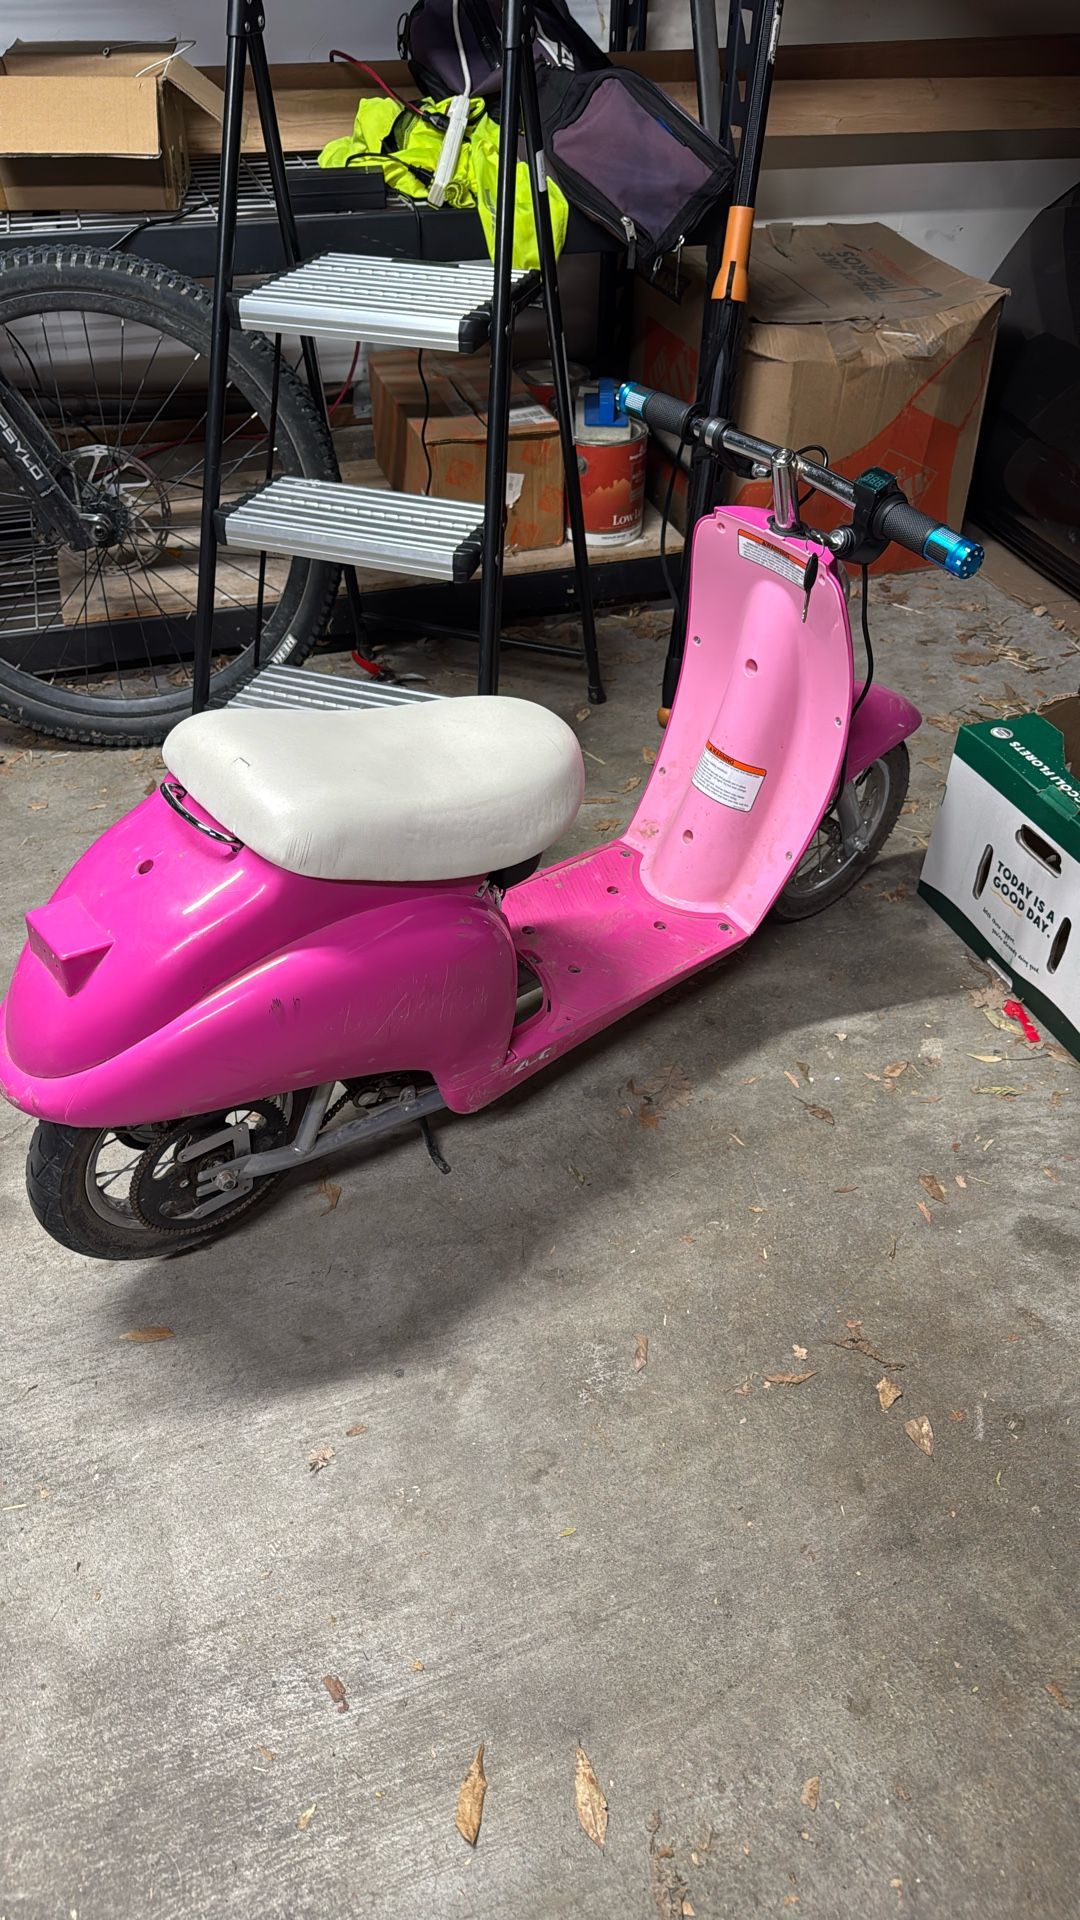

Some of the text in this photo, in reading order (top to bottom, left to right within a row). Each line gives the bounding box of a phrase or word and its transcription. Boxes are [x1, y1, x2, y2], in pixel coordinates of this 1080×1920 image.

[835, 251, 876, 275] PROS
[1009, 741, 1055, 776] FLORETS
[993, 876, 1051, 938] GOOD DAY.
[996, 860, 1055, 924] TODAY IS A
